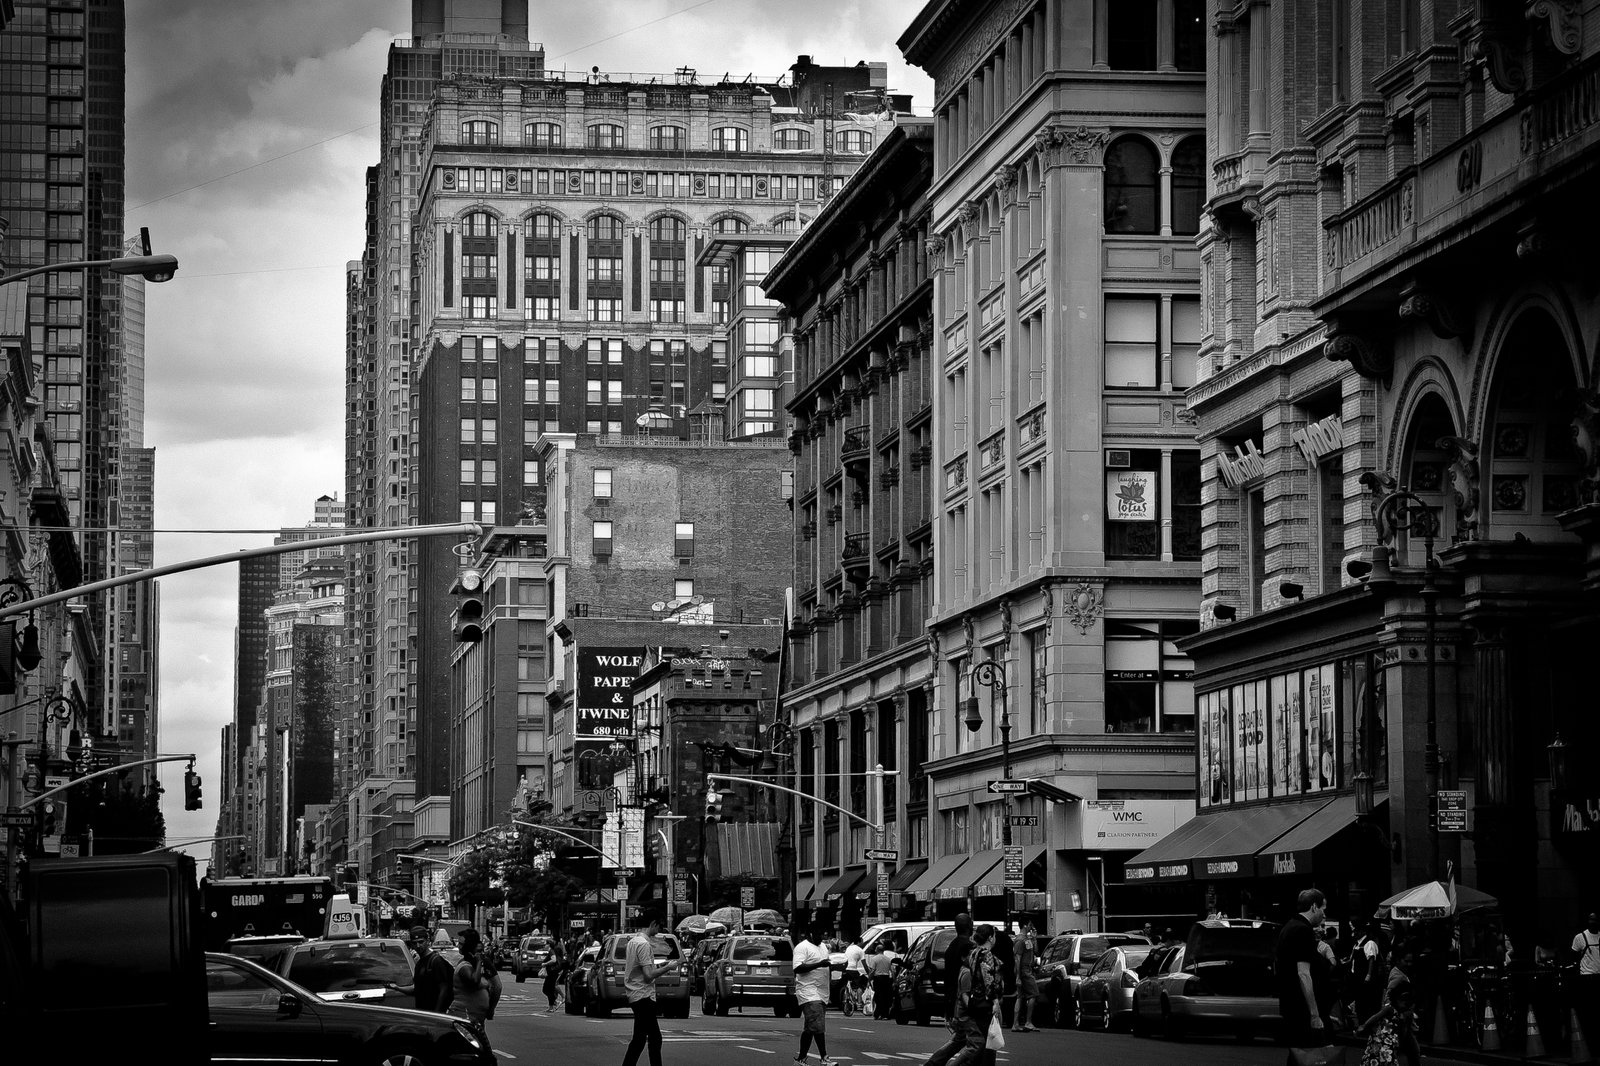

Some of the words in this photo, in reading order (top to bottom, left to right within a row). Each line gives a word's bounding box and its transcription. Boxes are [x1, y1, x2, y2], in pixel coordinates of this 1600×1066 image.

[1118, 473, 1147, 487] laughing
[1118, 499, 1147, 513] lotus
[596, 655, 642, 667] WOLF
[1120, 671, 1137, 679] Enter
[593, 676, 635, 688] PAPE
[611, 692, 624, 704] &
[578, 708, 630, 720] TWINE
[593, 726, 611, 736] 680
[1012, 817, 1018, 826] W
[1019, 817, 1026, 826] 19
[1029, 817, 1037, 826] ST
[1112, 812, 1143, 822] WMC
[1273, 852, 1296, 875] Marshalls
[231, 894, 265, 907] GARDA
[380, 908, 413, 916] CHSE
